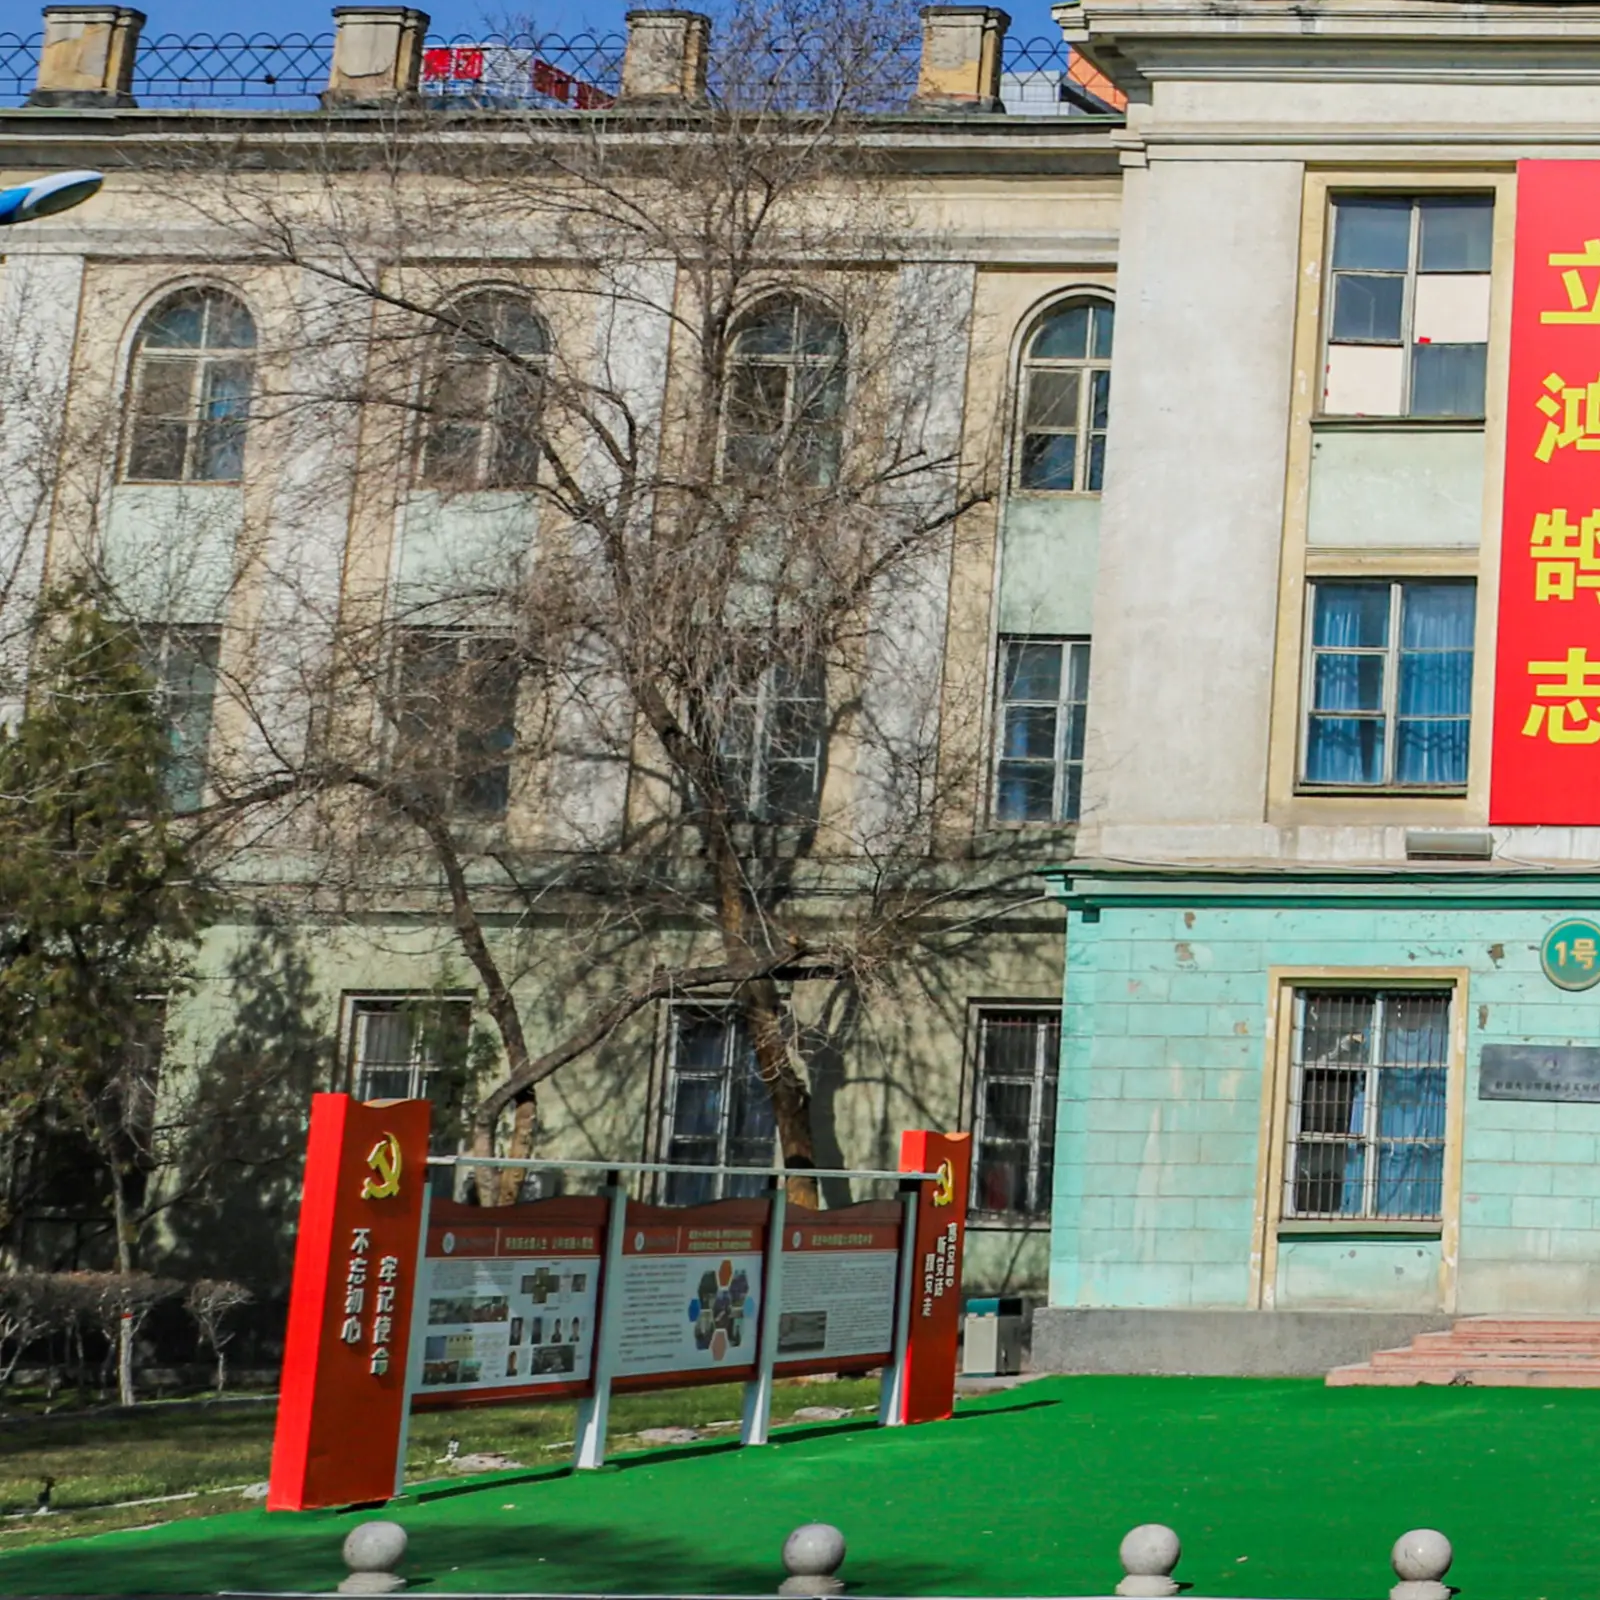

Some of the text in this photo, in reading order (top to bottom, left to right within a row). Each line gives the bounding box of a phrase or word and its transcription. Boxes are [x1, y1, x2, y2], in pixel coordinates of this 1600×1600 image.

[1554, 938, 1599, 970] 1号
[340, 1227, 371, 1344] 不忘初心
[369, 1255, 399, 1376] 牢记使命
